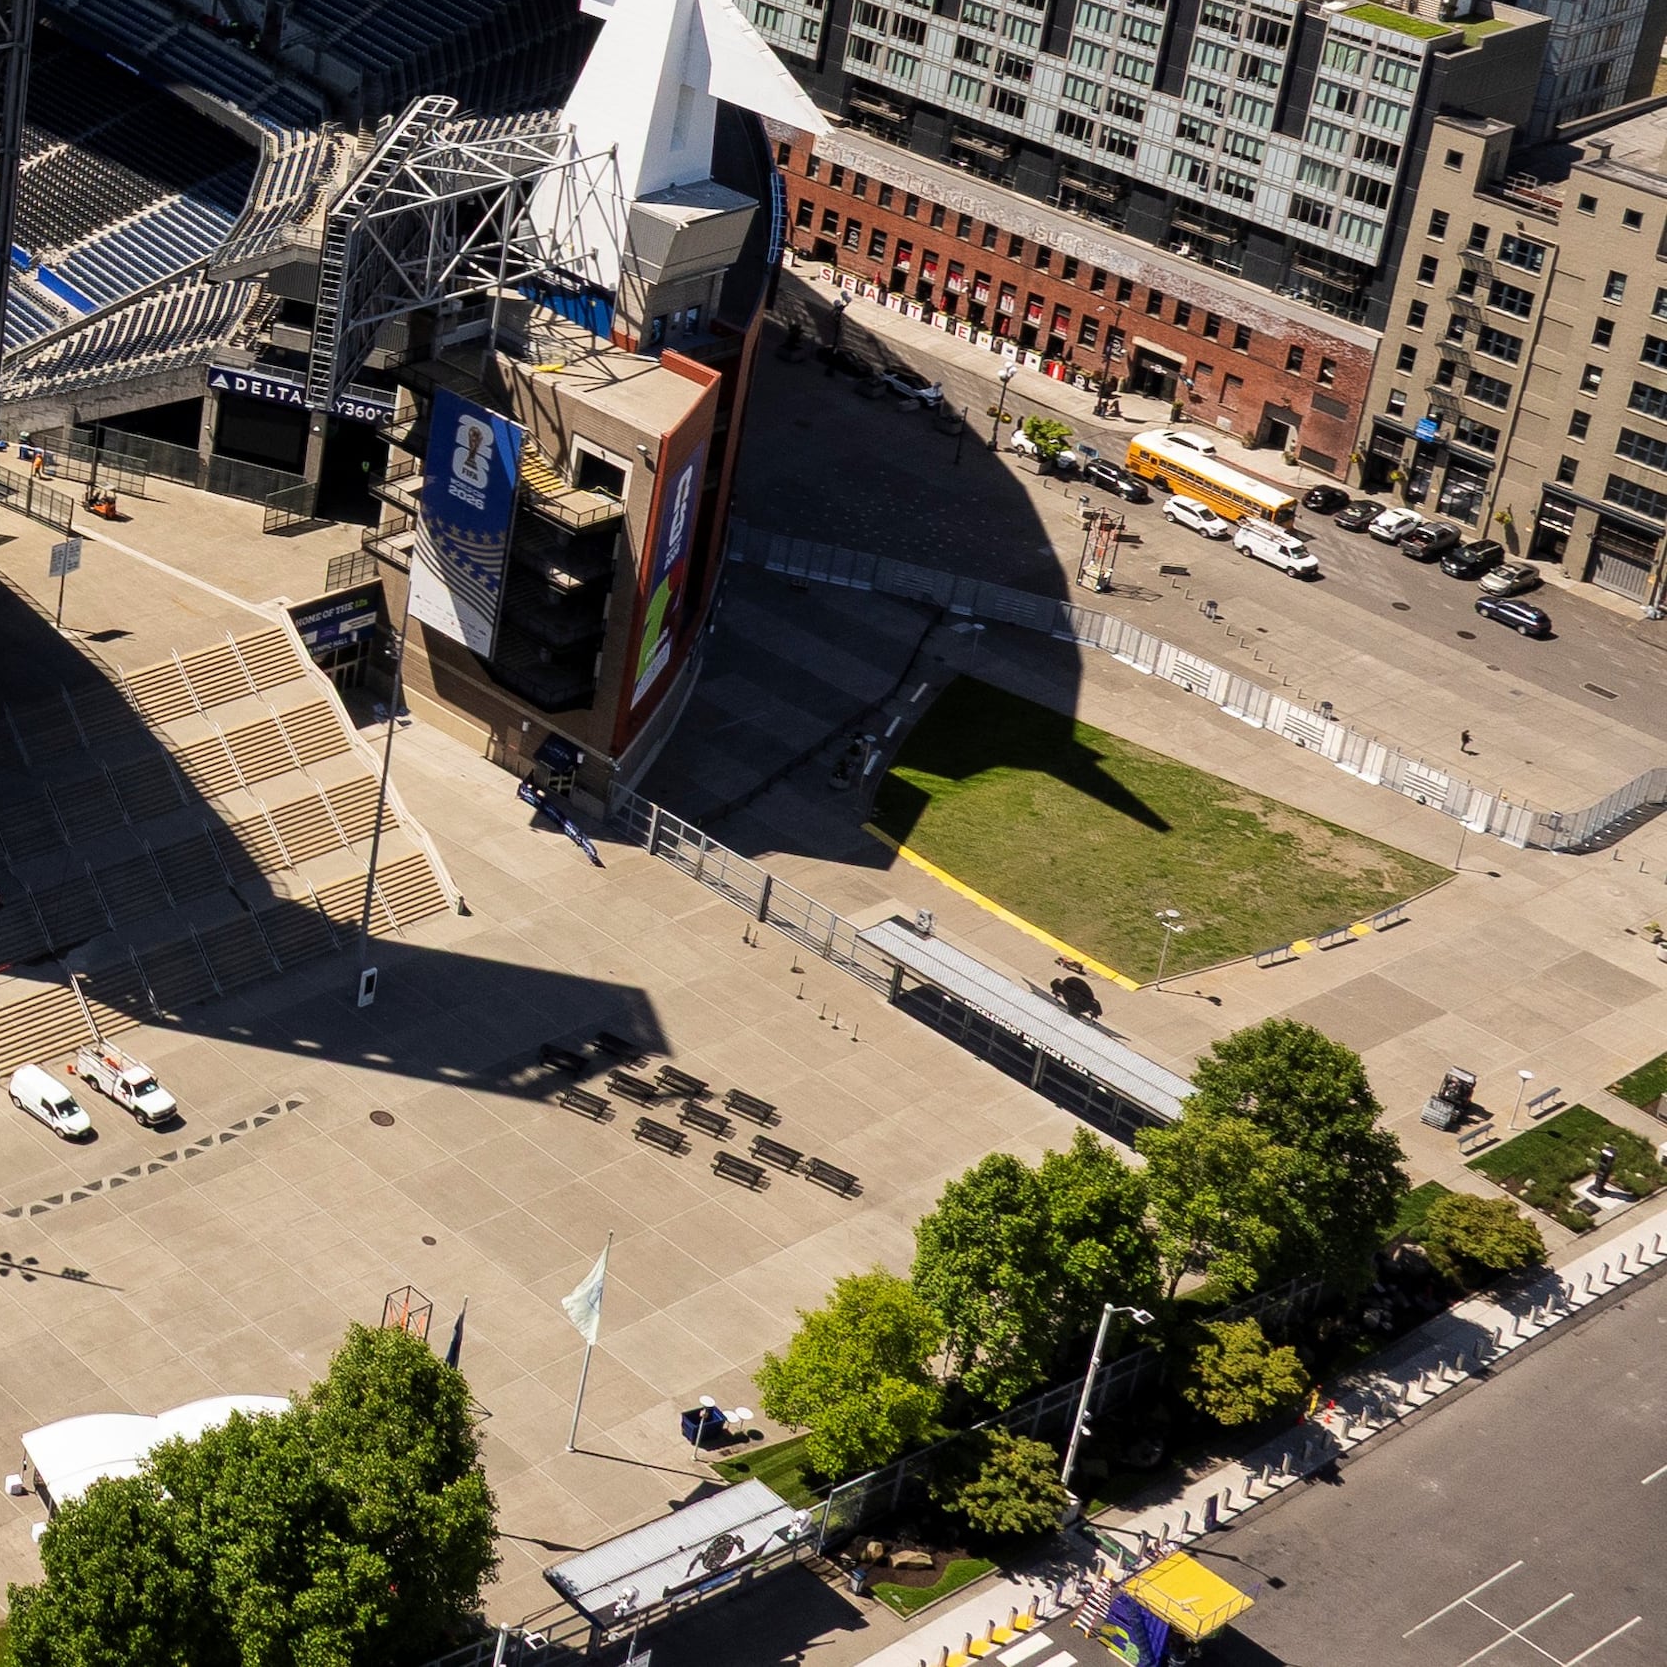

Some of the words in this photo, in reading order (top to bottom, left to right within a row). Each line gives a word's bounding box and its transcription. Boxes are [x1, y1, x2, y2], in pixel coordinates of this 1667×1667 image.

[822, 268, 968, 340] SEATTLE
[234, 377, 301, 404] DELTA
[461, 467, 478, 482] FIFA
[448, 484, 485, 510] 2026
[295, 611, 322, 628] HOME
[322, 607, 335, 620] OF
[335, 602, 354, 615] THE
[965, 999, 1021, 1038] MUCKLESHOOT
[1022, 1033, 1062, 1060] HERITAGE
[1063, 1055, 1089, 1076] PLAZA
